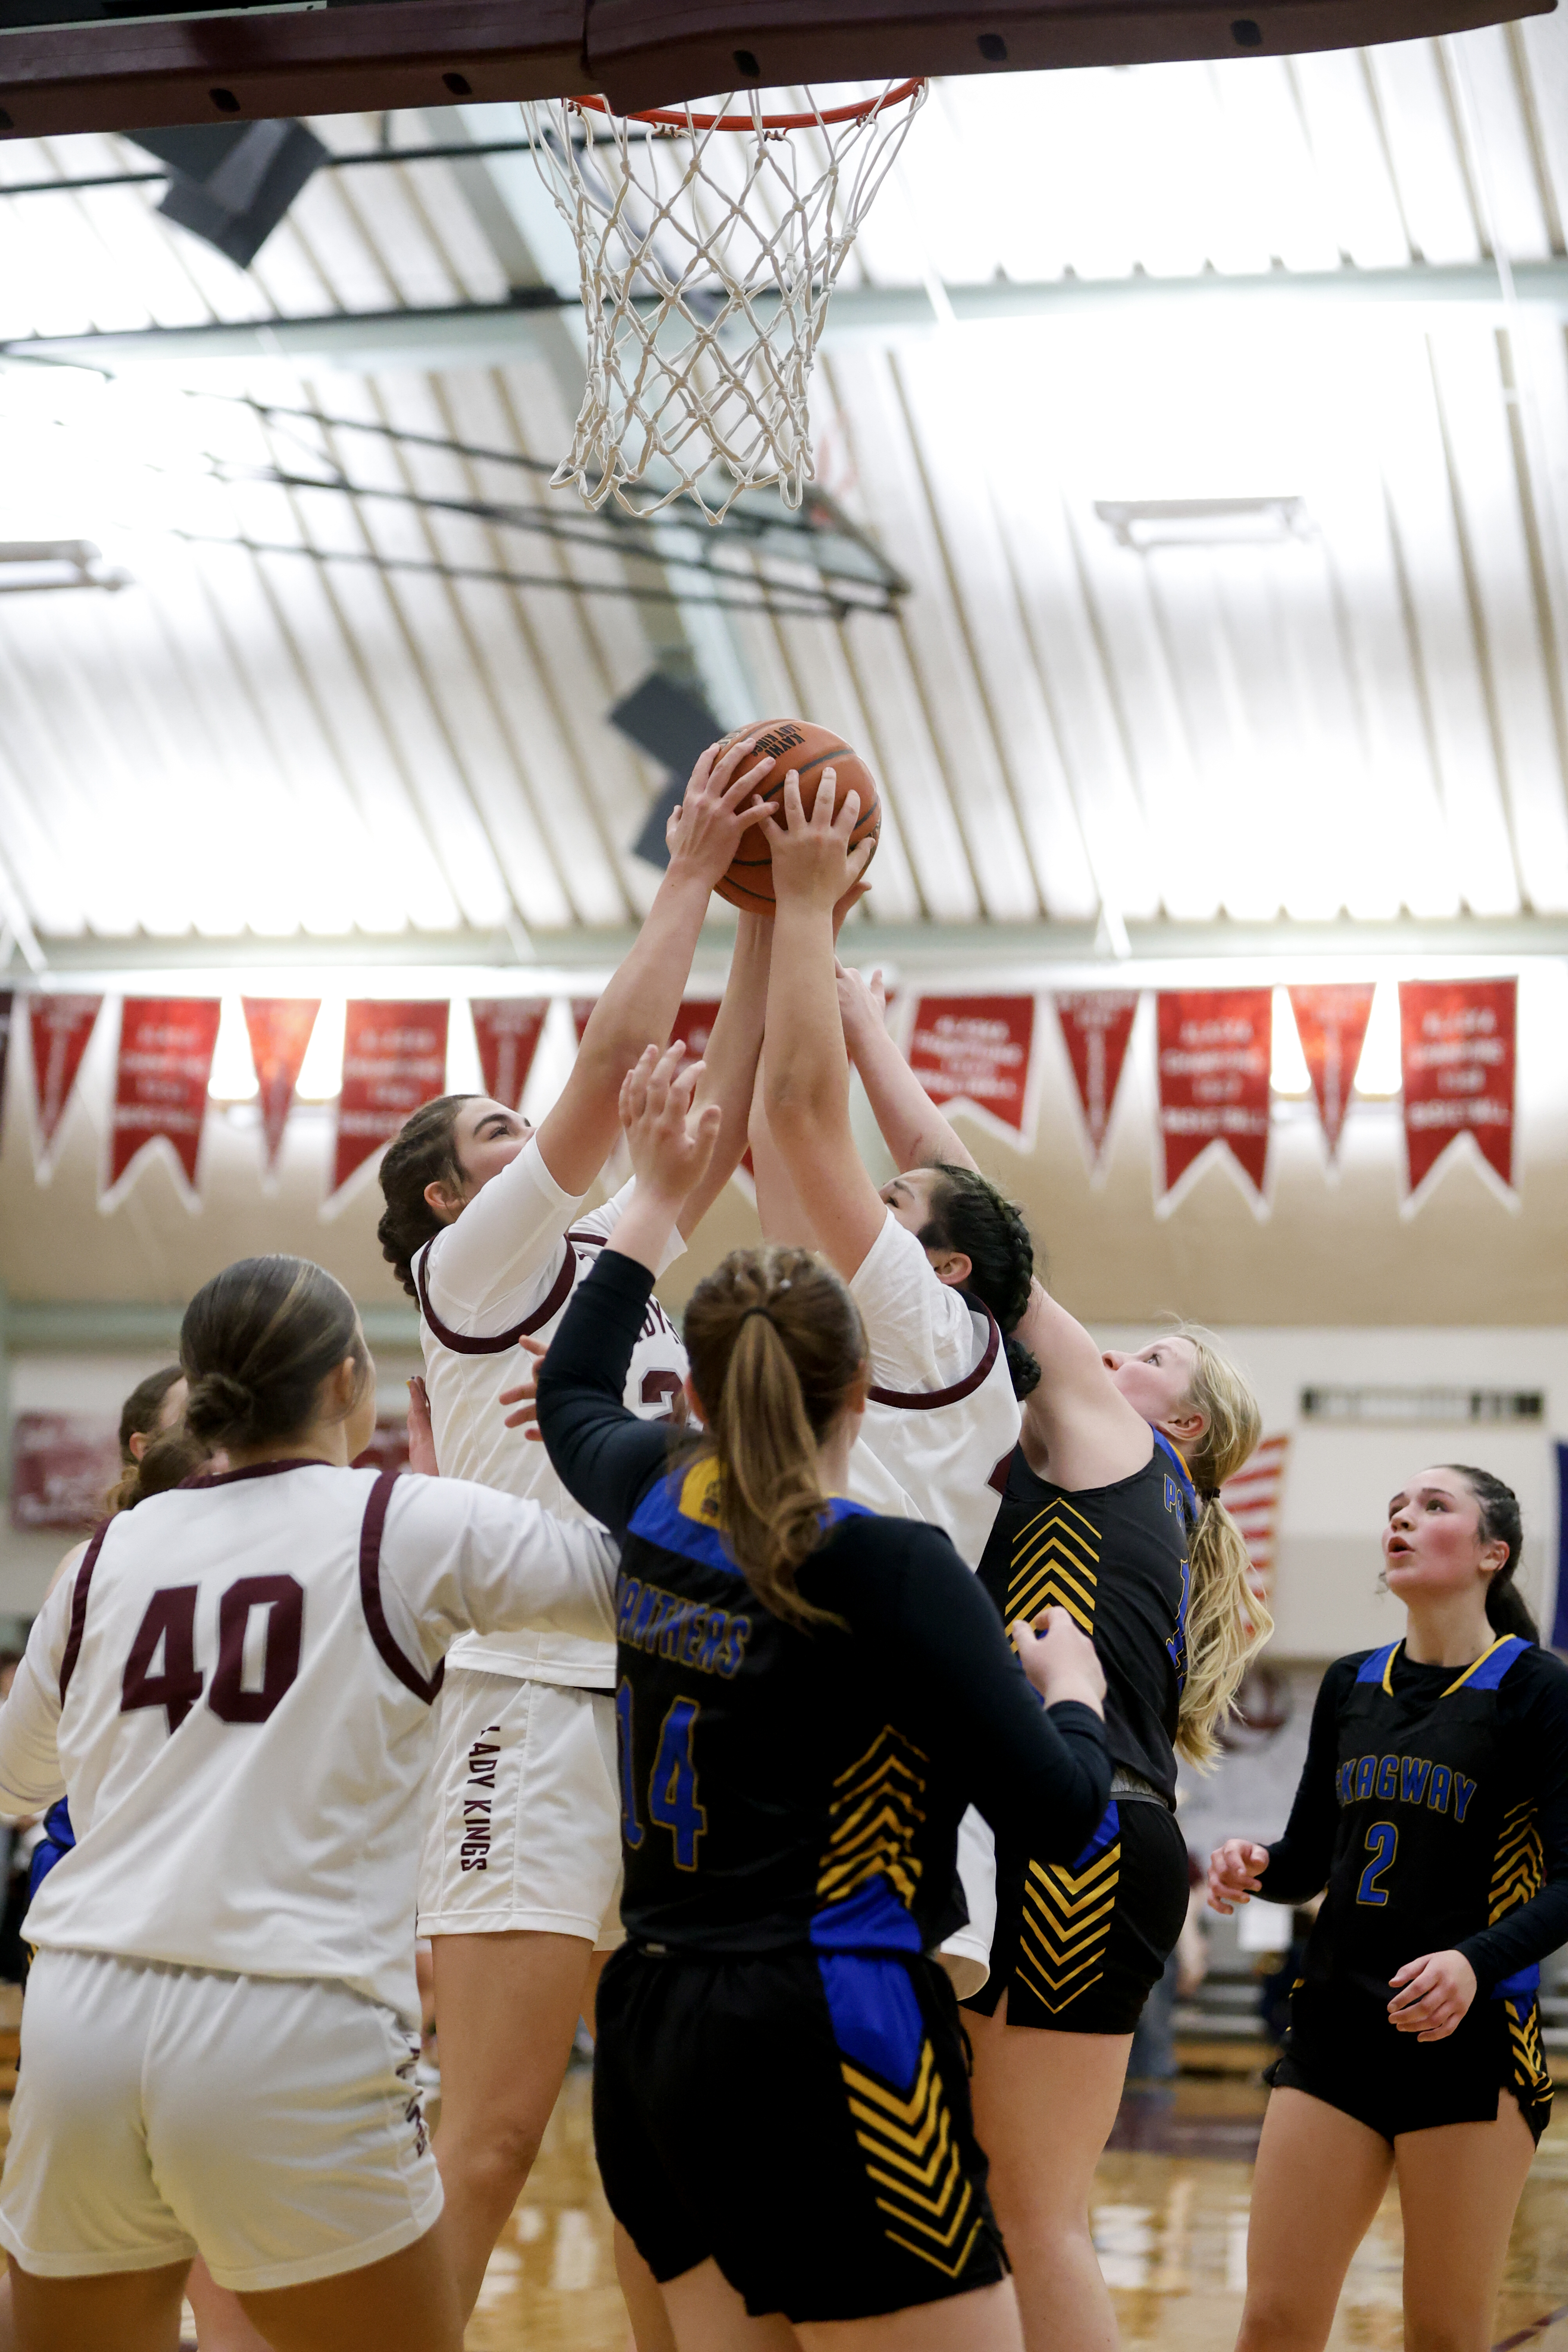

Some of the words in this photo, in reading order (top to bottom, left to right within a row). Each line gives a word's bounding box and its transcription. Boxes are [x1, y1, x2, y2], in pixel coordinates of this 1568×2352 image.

[764, 733, 806, 759] KAYHI
[773, 724, 802, 738] LADY
[118, 1572, 307, 1737] 40
[617, 1573, 753, 1679] ANTHERS
[466, 1726, 501, 1788] LADY
[615, 1675, 708, 1872] 14
[460, 1800, 492, 1871] KINGS
[1356, 1821, 1399, 1907] 2
